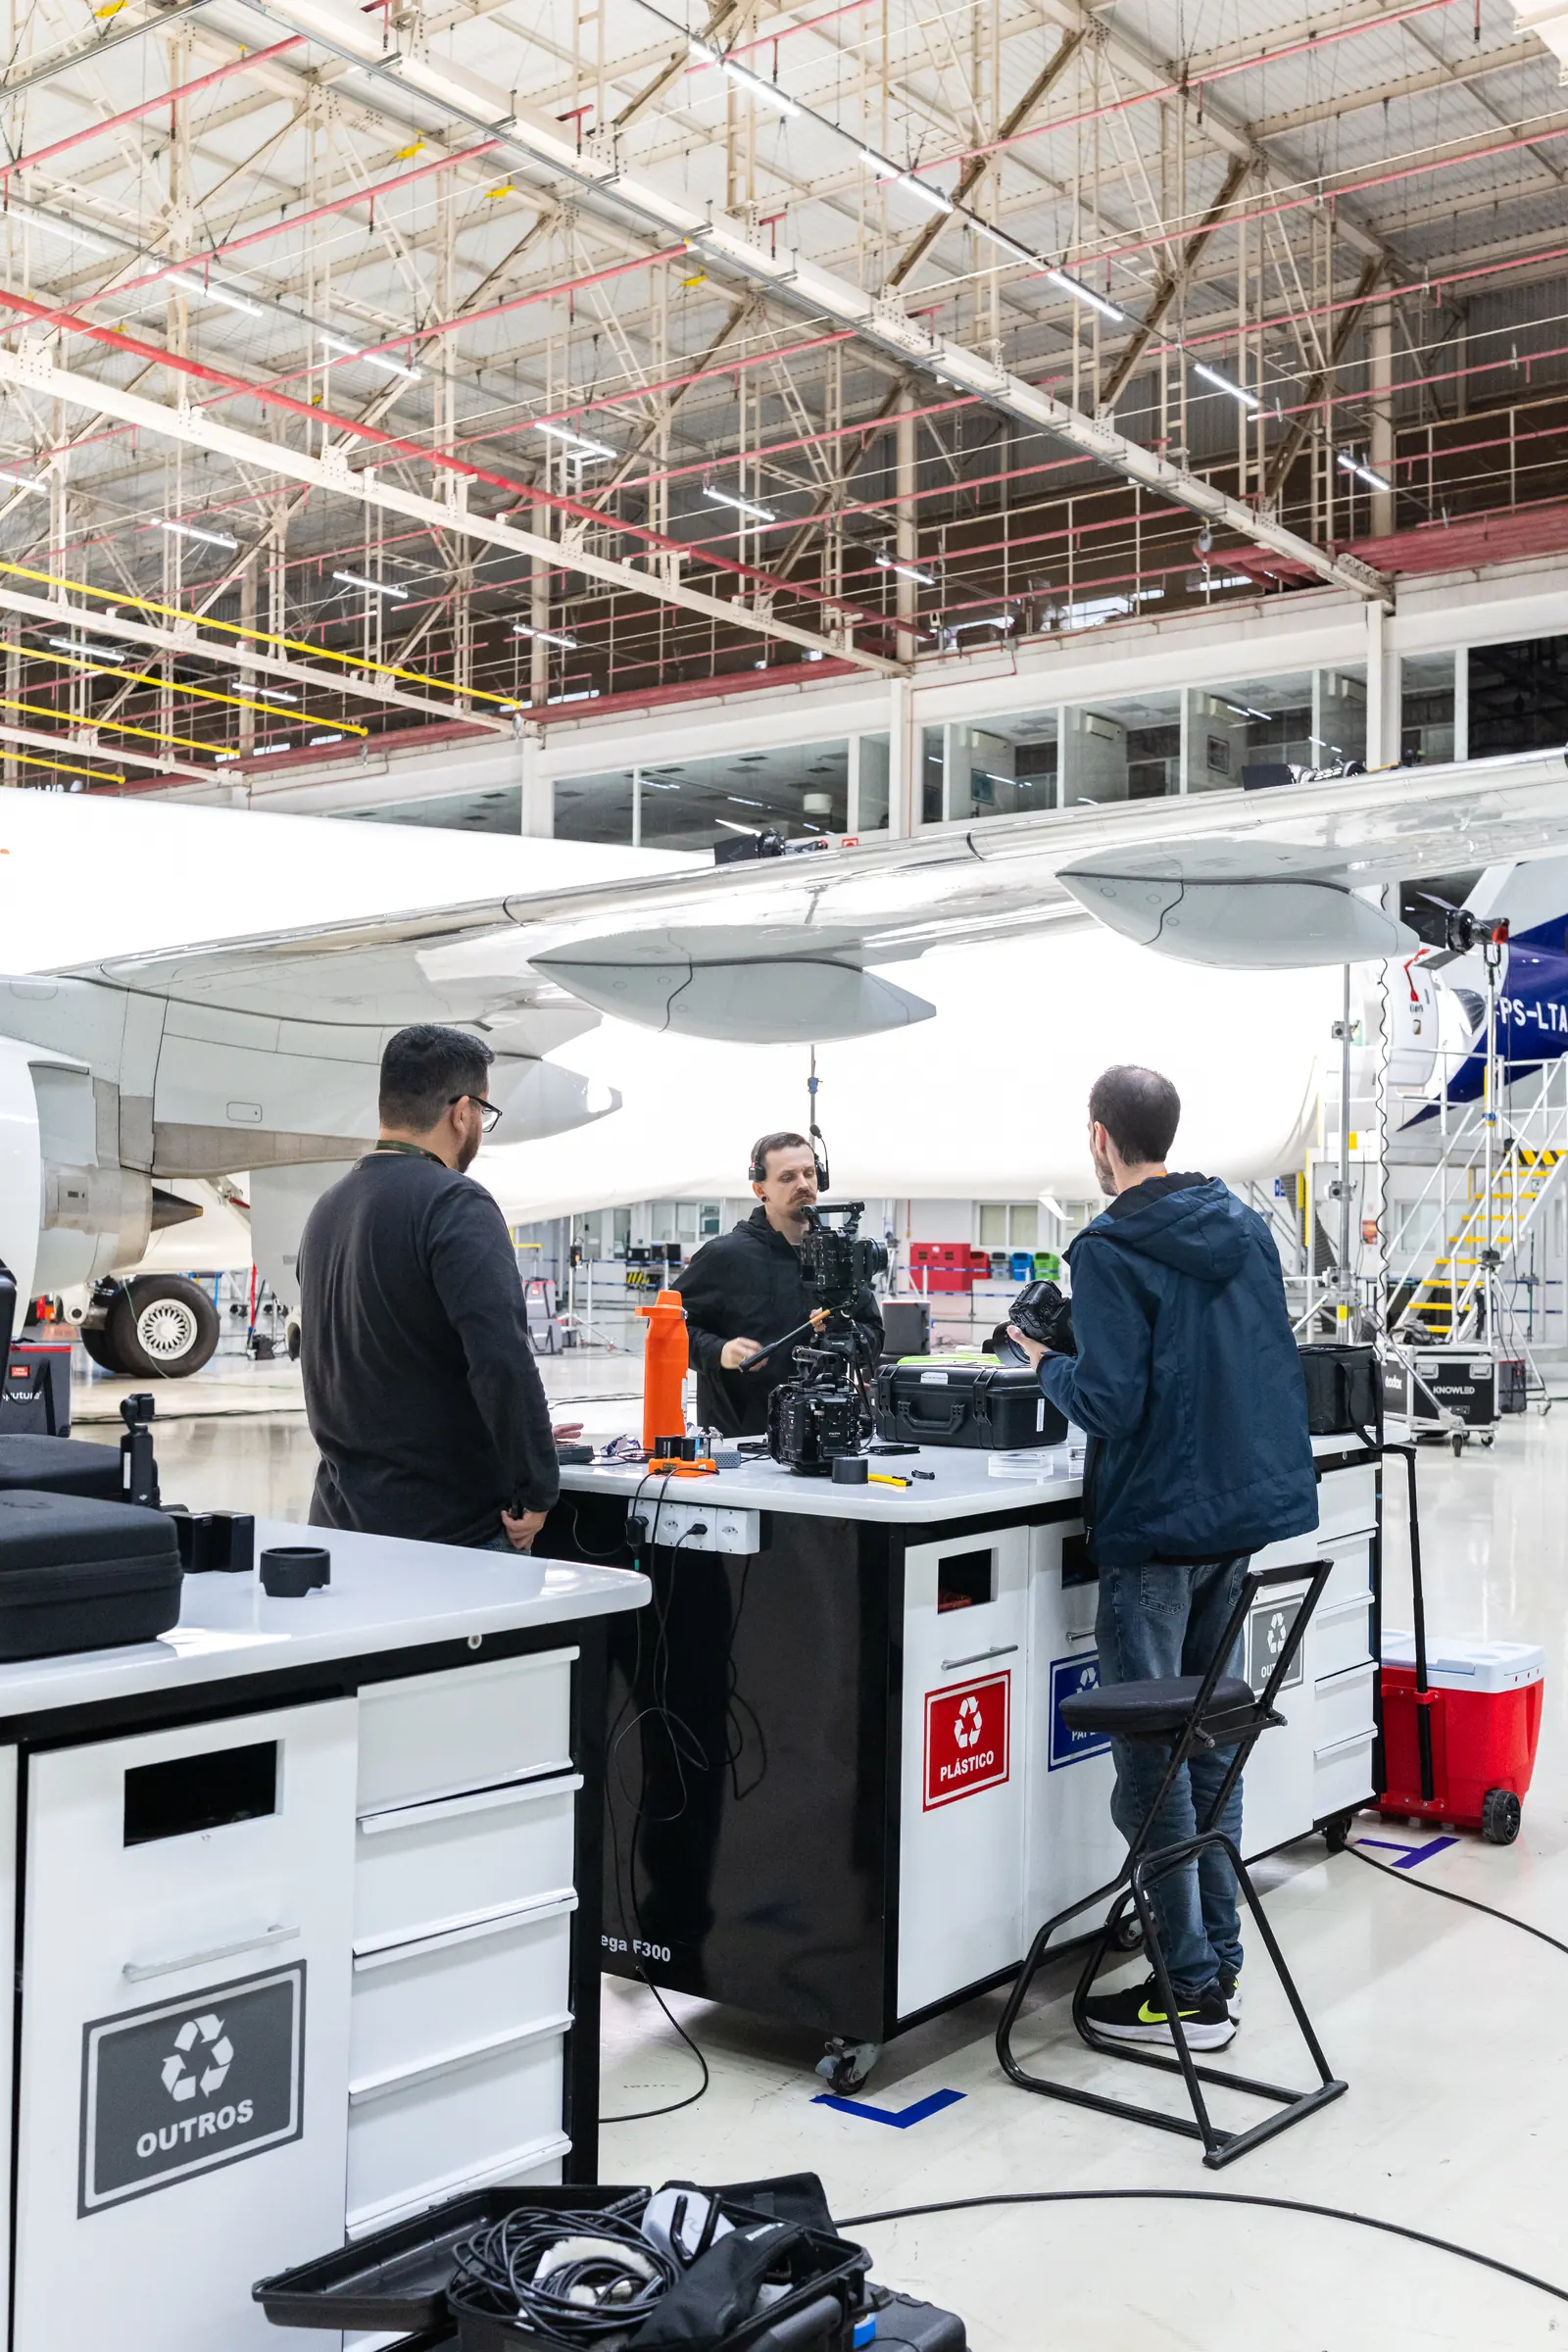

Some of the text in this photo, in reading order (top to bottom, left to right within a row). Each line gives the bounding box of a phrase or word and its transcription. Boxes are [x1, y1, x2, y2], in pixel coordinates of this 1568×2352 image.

[1499, 996, 1568, 1033] PS-LTA
[1433, 1386, 1475, 1395] KNOWLED
[940, 1750, 995, 1782] PLÁSTICO
[632, 1938, 671, 1962] F300
[136, 2099, 254, 2158] OUTROS
